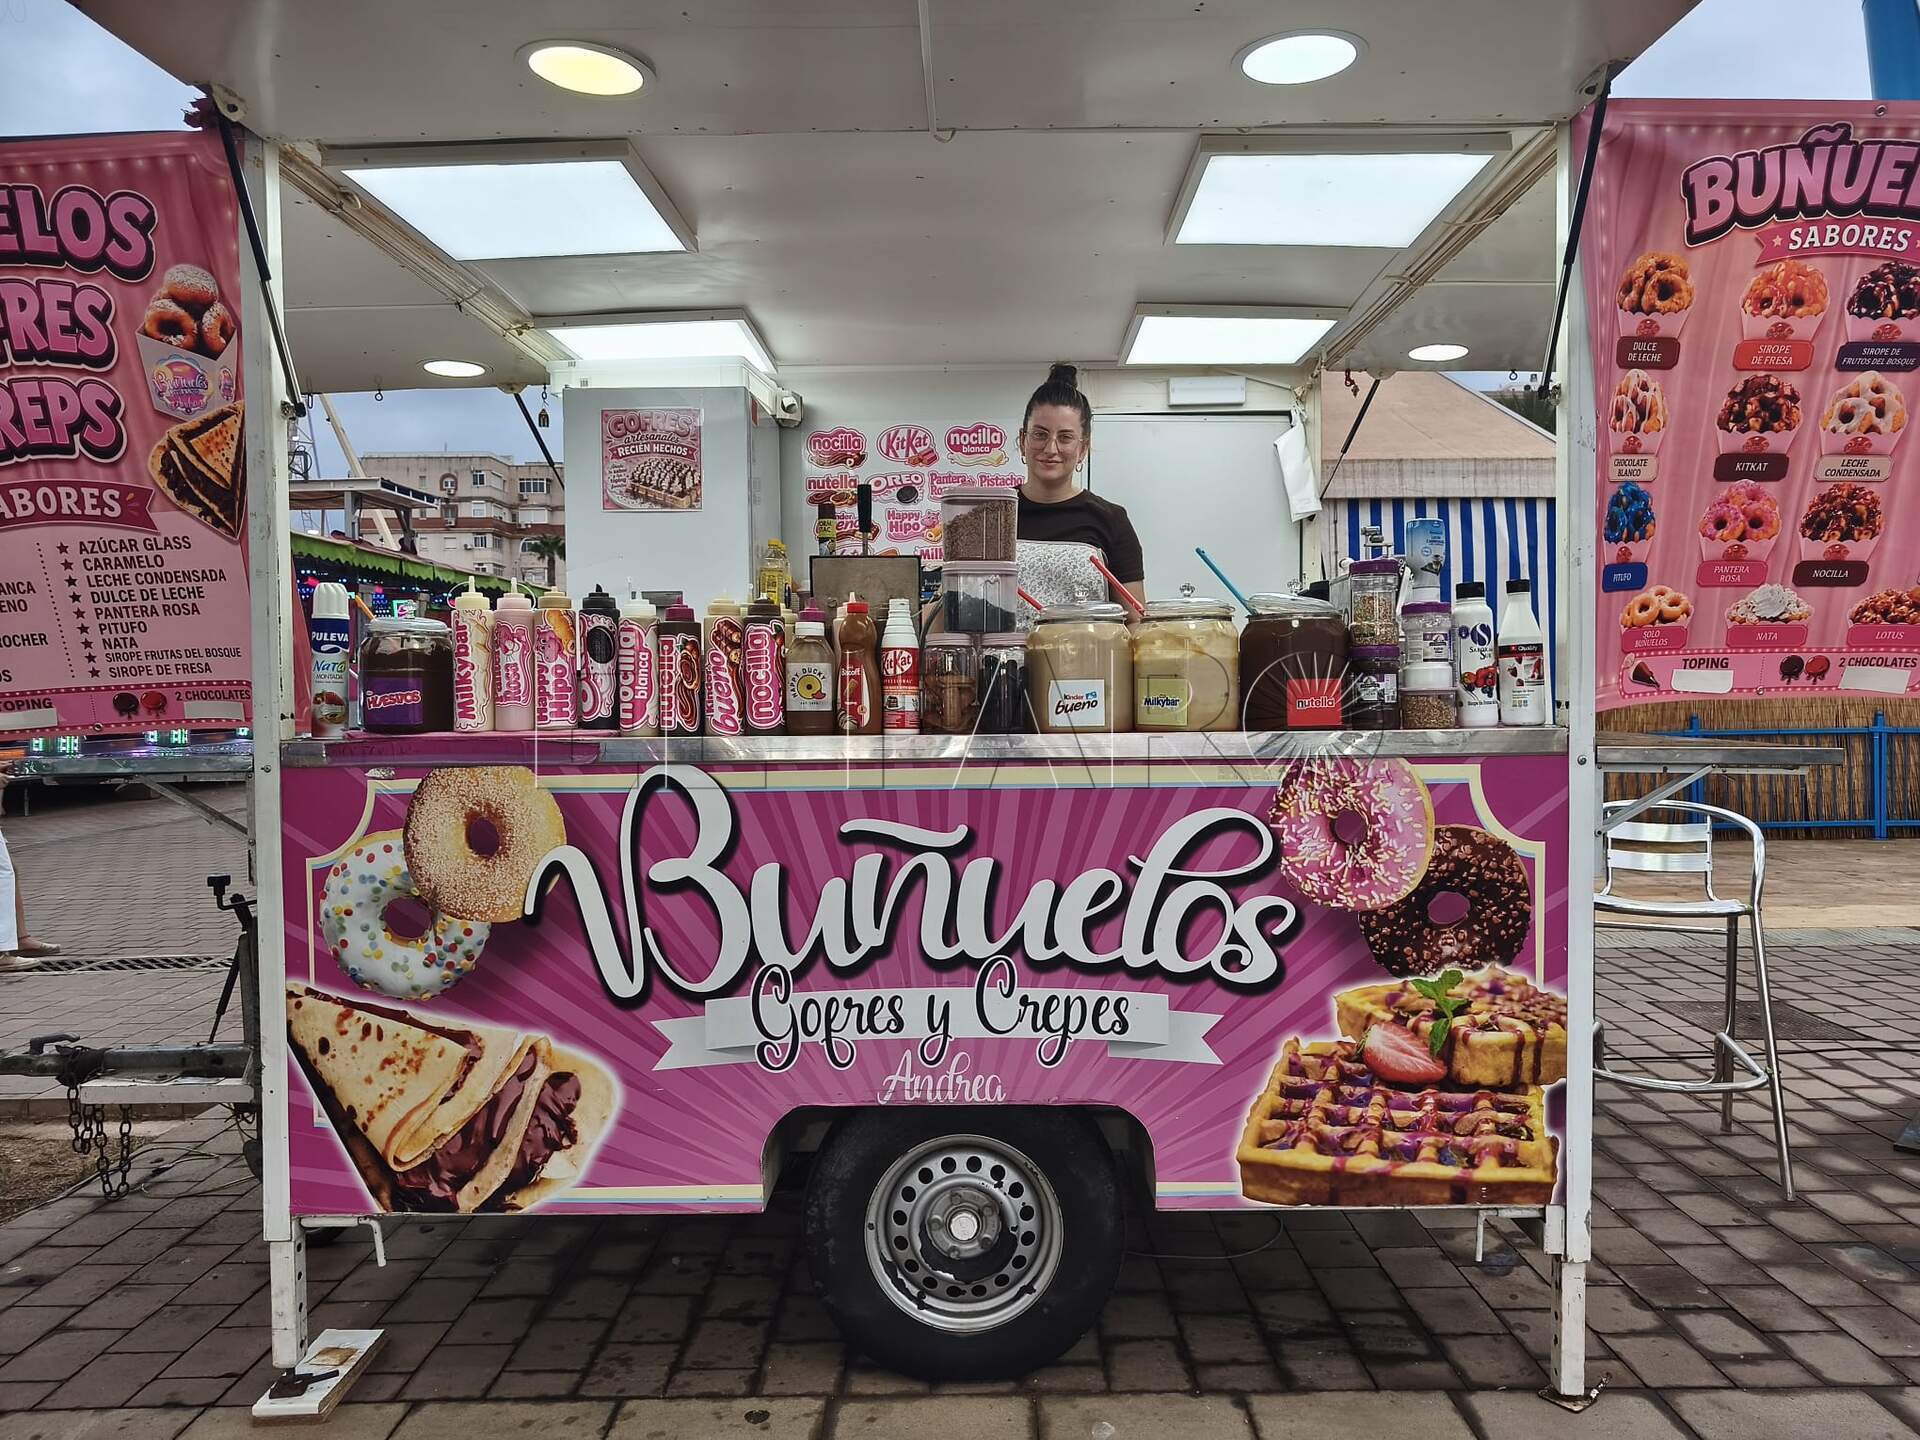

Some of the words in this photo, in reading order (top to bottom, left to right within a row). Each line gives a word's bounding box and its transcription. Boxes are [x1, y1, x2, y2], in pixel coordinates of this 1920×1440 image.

[1788, 223, 1912, 252] SABORES
[1632, 341, 1657, 351] DULCE
[1757, 344, 1792, 354] SIROPE
[1861, 347, 1890, 356] SIROPE
[1890, 347, 1902, 356] DE
[1627, 352, 1638, 361] DE
[1638, 353, 1662, 362] LECHE
[1751, 356, 1765, 365] DE
[1765, 356, 1793, 365] FRESA
[1841, 357, 1870, 365] FRUTOS
[608, 411, 693, 438] GOFRES
[624, 432, 680, 444] artesanales
[810, 434, 863, 451] nocilla
[885, 427, 928, 457] KitKat
[950, 427, 1002, 446] nocilla
[653, 444, 688, 456] HECHOS
[962, 444, 990, 453] blanca
[1613, 458, 1648, 467] CHOCOLATE
[1735, 462, 1768, 472] KITKAT
[1840, 458, 1869, 467] LECHE
[930, 473, 967, 485] Pantera
[1617, 468, 1641, 477] BLANCO
[1824, 468, 1881, 478] CONDENSADA
[807, 475, 858, 490] nutella
[868, 472, 924, 491] OREO
[979, 474, 1024, 487] Pistacho
[887, 509, 920, 522] Happy
[888, 519, 920, 534] Hipo
[79, 536, 140, 555] AZÚCAR
[143, 535, 192, 551] GLASS
[82, 554, 165, 571] CARAMELO
[1713, 566, 1750, 574] PANTERA
[1812, 569, 1849, 578] NOCILLA
[86, 573, 132, 588] LECHE
[134, 569, 227, 586] CONDENSADA
[1719, 574, 1741, 583] ROSA
[90, 589, 137, 604] DULCE
[139, 587, 159, 601] DE
[161, 585, 205, 600] LECHE
[94, 604, 159, 620] PANTERA
[162, 602, 201, 617] ROSA
[98, 620, 148, 635] PITUFO
[1642, 630, 1661, 639] SOLO
[311, 631, 349, 642] PULEVA
[1756, 632, 1778, 641] NATA
[1875, 631, 1904, 640] LOTUS
[101, 636, 139, 650] NATA
[105, 651, 143, 663] SIROPE
[145, 649, 182, 661] FRUTAS
[184, 648, 204, 659] DEL
[205, 647, 241, 659] BOSQUE
[1838, 657, 1845, 667] 2
[1847, 656, 1918, 668] CHOCOLATES
[108, 664, 155, 678] SIROPE
[156, 664, 172, 676] DE
[174, 662, 212, 675] FRESA
[1682, 657, 1729, 669] TOPING
[455, 622, 476, 720] Milkybar
[618, 630, 636, 719] nocilla
[635, 651, 649, 699] blanca
[747, 631, 775, 719] nocilla
[659, 638, 676, 728] nutella
[175, 692, 183, 701] 2
[184, 689, 251, 701] CHOCOLATES
[549, 663, 573, 718] Hipo
[709, 650, 739, 733] bueno
[1055, 699, 1098, 715] bueno
[1143, 697, 1180, 707] Milkybar
[1296, 695, 1336, 709] nutella
[524, 764, 1297, 999] Buñuelos
[750, 959, 906, 1073] Gofres
[925, 994, 953, 1065] y
[974, 955, 1131, 1068] Crepes
[876, 1047, 1007, 1104] Andrea
